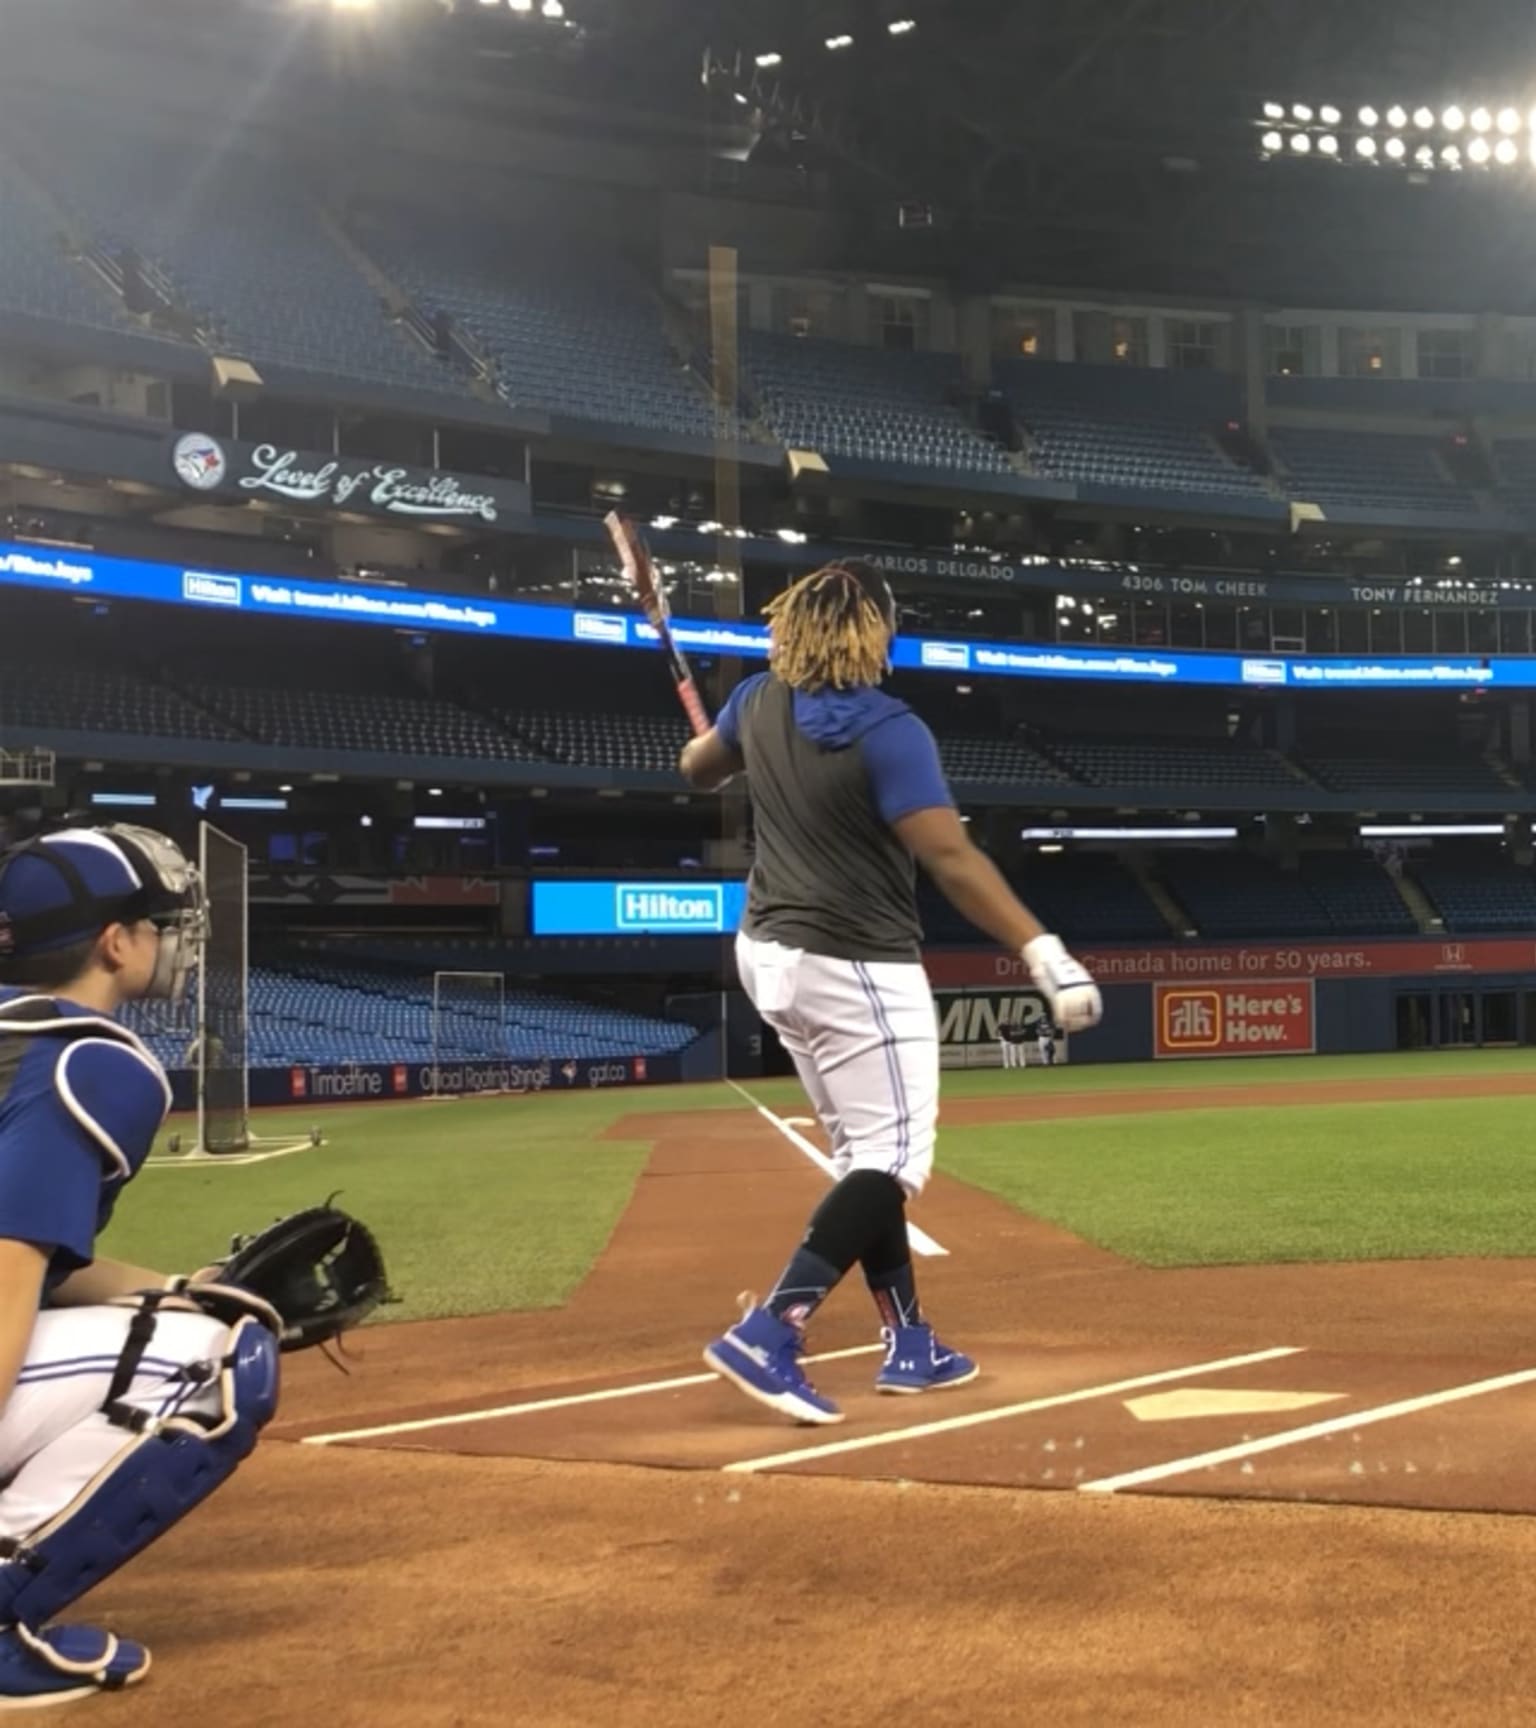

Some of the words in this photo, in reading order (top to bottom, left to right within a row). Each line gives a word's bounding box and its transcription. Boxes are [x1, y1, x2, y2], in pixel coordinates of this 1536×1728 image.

[239, 443, 337, 498] Level
[332, 472, 369, 504] of
[370, 465, 497, 521] Excellence
[936, 560, 1015, 581] DELGADO
[1170, 577, 1208, 593] TOM
[1215, 580, 1268, 596] CHEEK
[1351, 586, 1396, 601] TONY
[1403, 587, 1499, 605] FERNANDEZ
[624, 892, 715, 920] Hilton
[1083, 950, 1166, 974] Canada
[1170, 950, 1233, 972] home
[1237, 949, 1268, 971] for
[1274, 950, 1300, 970] 50
[1305, 950, 1372, 974] years.
[1225, 993, 1304, 1017] Here's
[938, 997, 1045, 1042] MNP
[1225, 1019, 1289, 1043] How.
